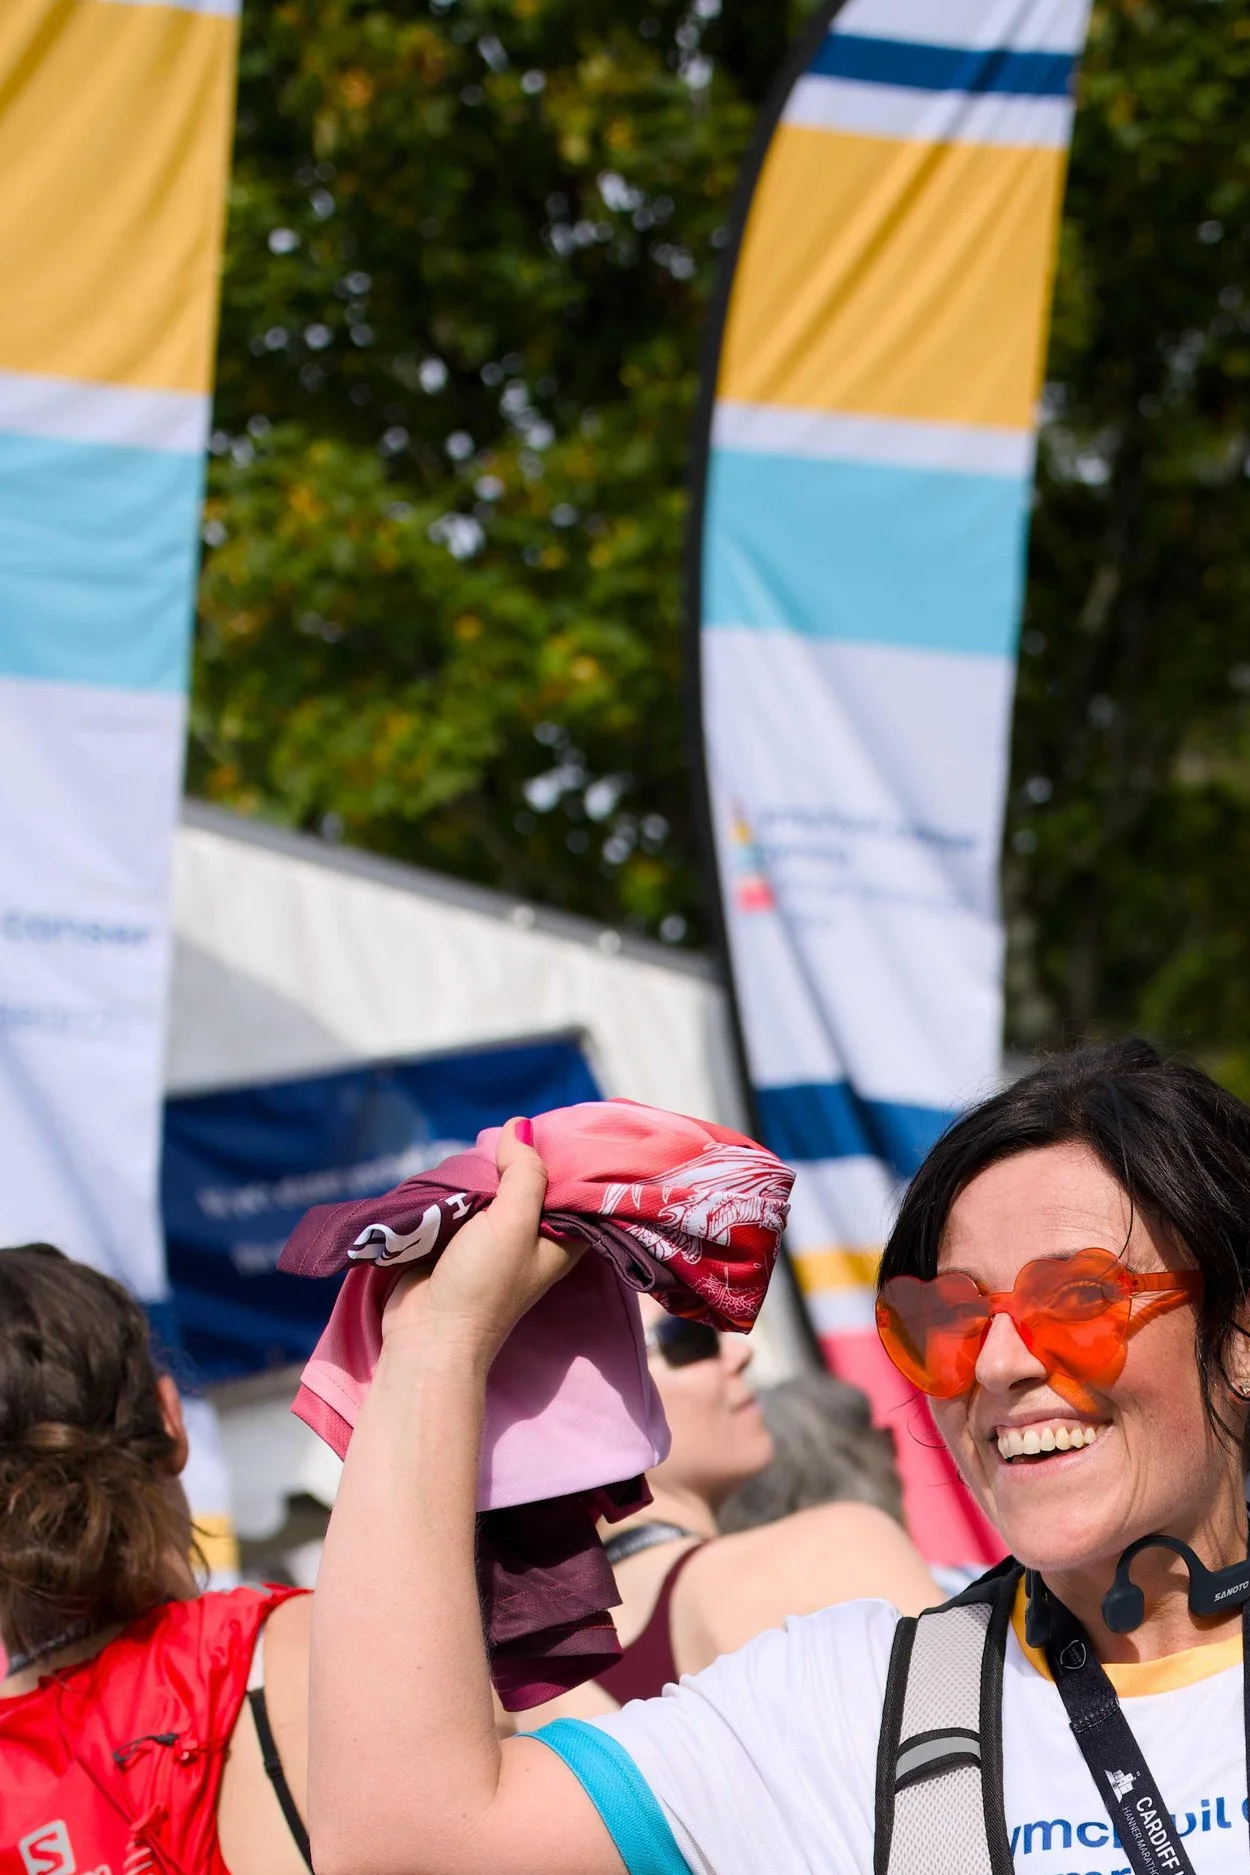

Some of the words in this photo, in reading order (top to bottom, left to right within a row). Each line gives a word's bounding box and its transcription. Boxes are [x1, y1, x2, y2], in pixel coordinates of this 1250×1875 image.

[1214, 1581, 1249, 1602] SANOTO
[1123, 1805, 1142, 1841] HANNER
[1136, 1796, 1180, 1869] CARDIFF
